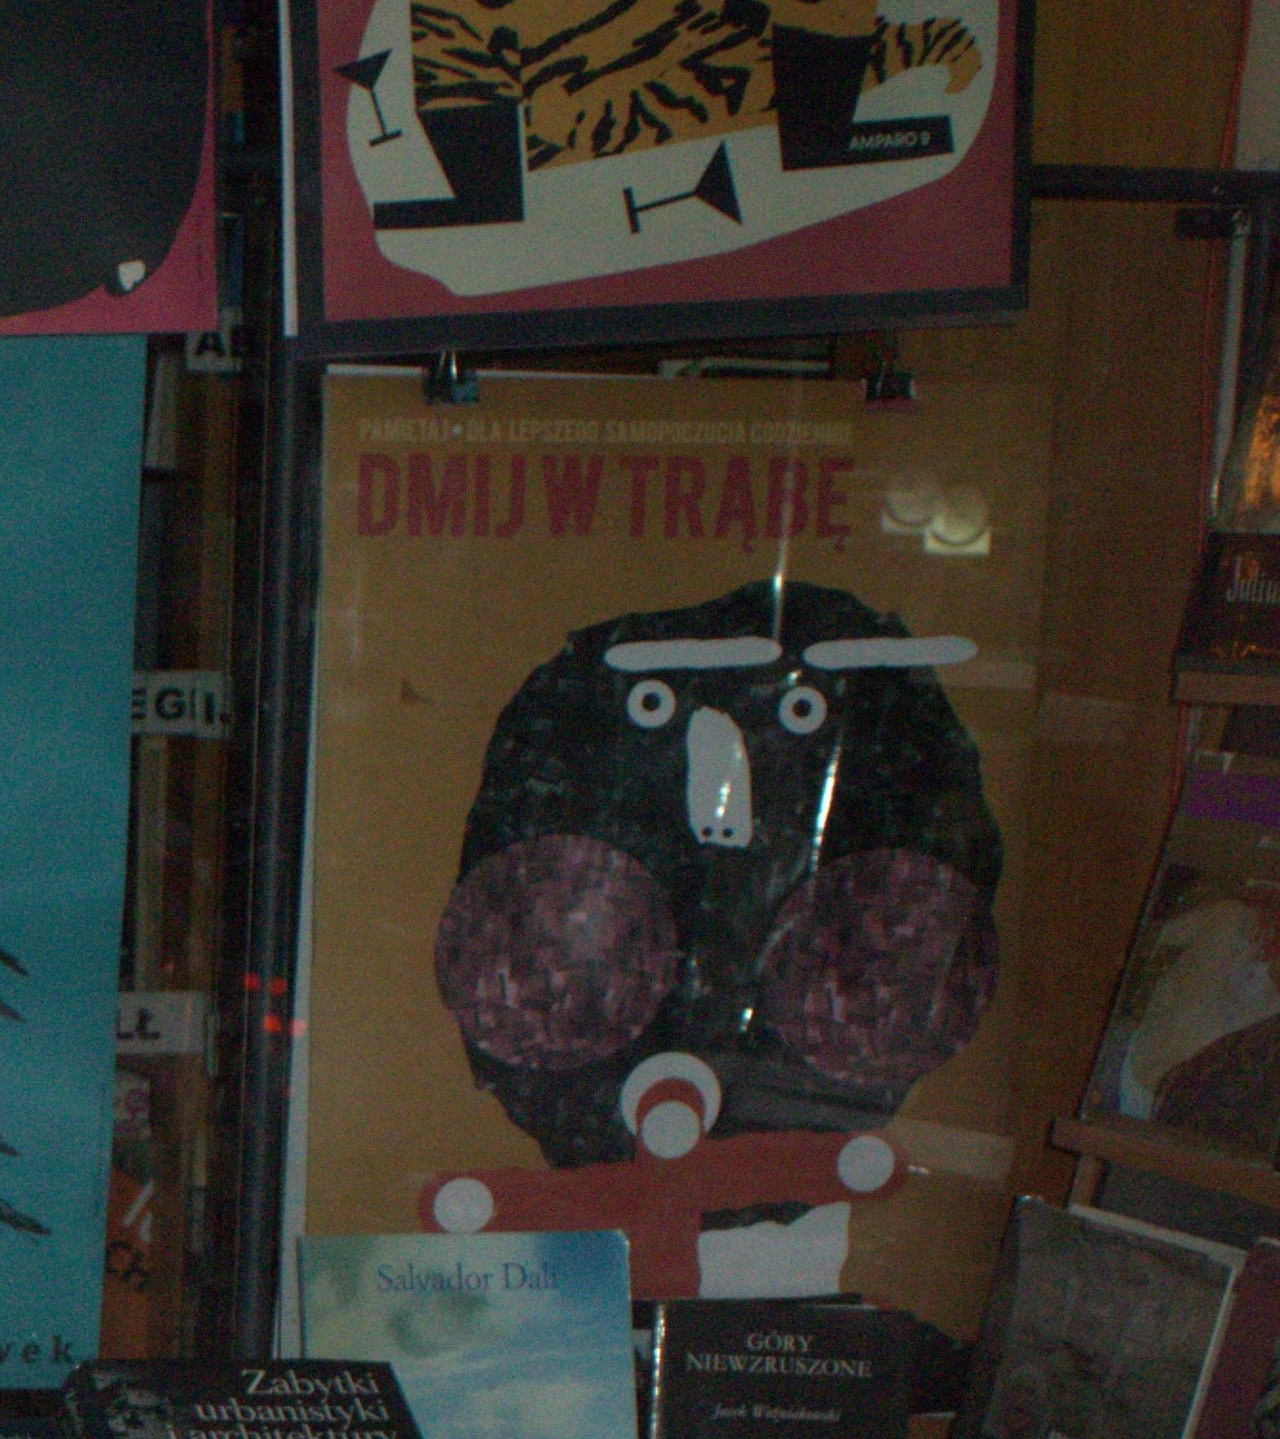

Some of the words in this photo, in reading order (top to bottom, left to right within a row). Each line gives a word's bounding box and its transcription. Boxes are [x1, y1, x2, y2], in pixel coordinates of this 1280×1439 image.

[358, 418, 450, 444] PAMIĘTAJ
[466, 419, 503, 443] DLA
[507, 419, 599, 443] LEPSZEGO
[604, 419, 746, 443] SAMOPOCZUCIA
[357, 453, 526, 538] DMIJ
[542, 453, 604, 538] W
[618, 453, 857, 554] TRĄBĘ
[377, 1262, 493, 1293] Salvador
[745, 1330, 815, 1353] GÓRY
[685, 1352, 873, 1379] NIEWZRUSZONE
[240, 1367, 381, 1403] Zabytki
[192, 1396, 390, 1429] urbanistyki
